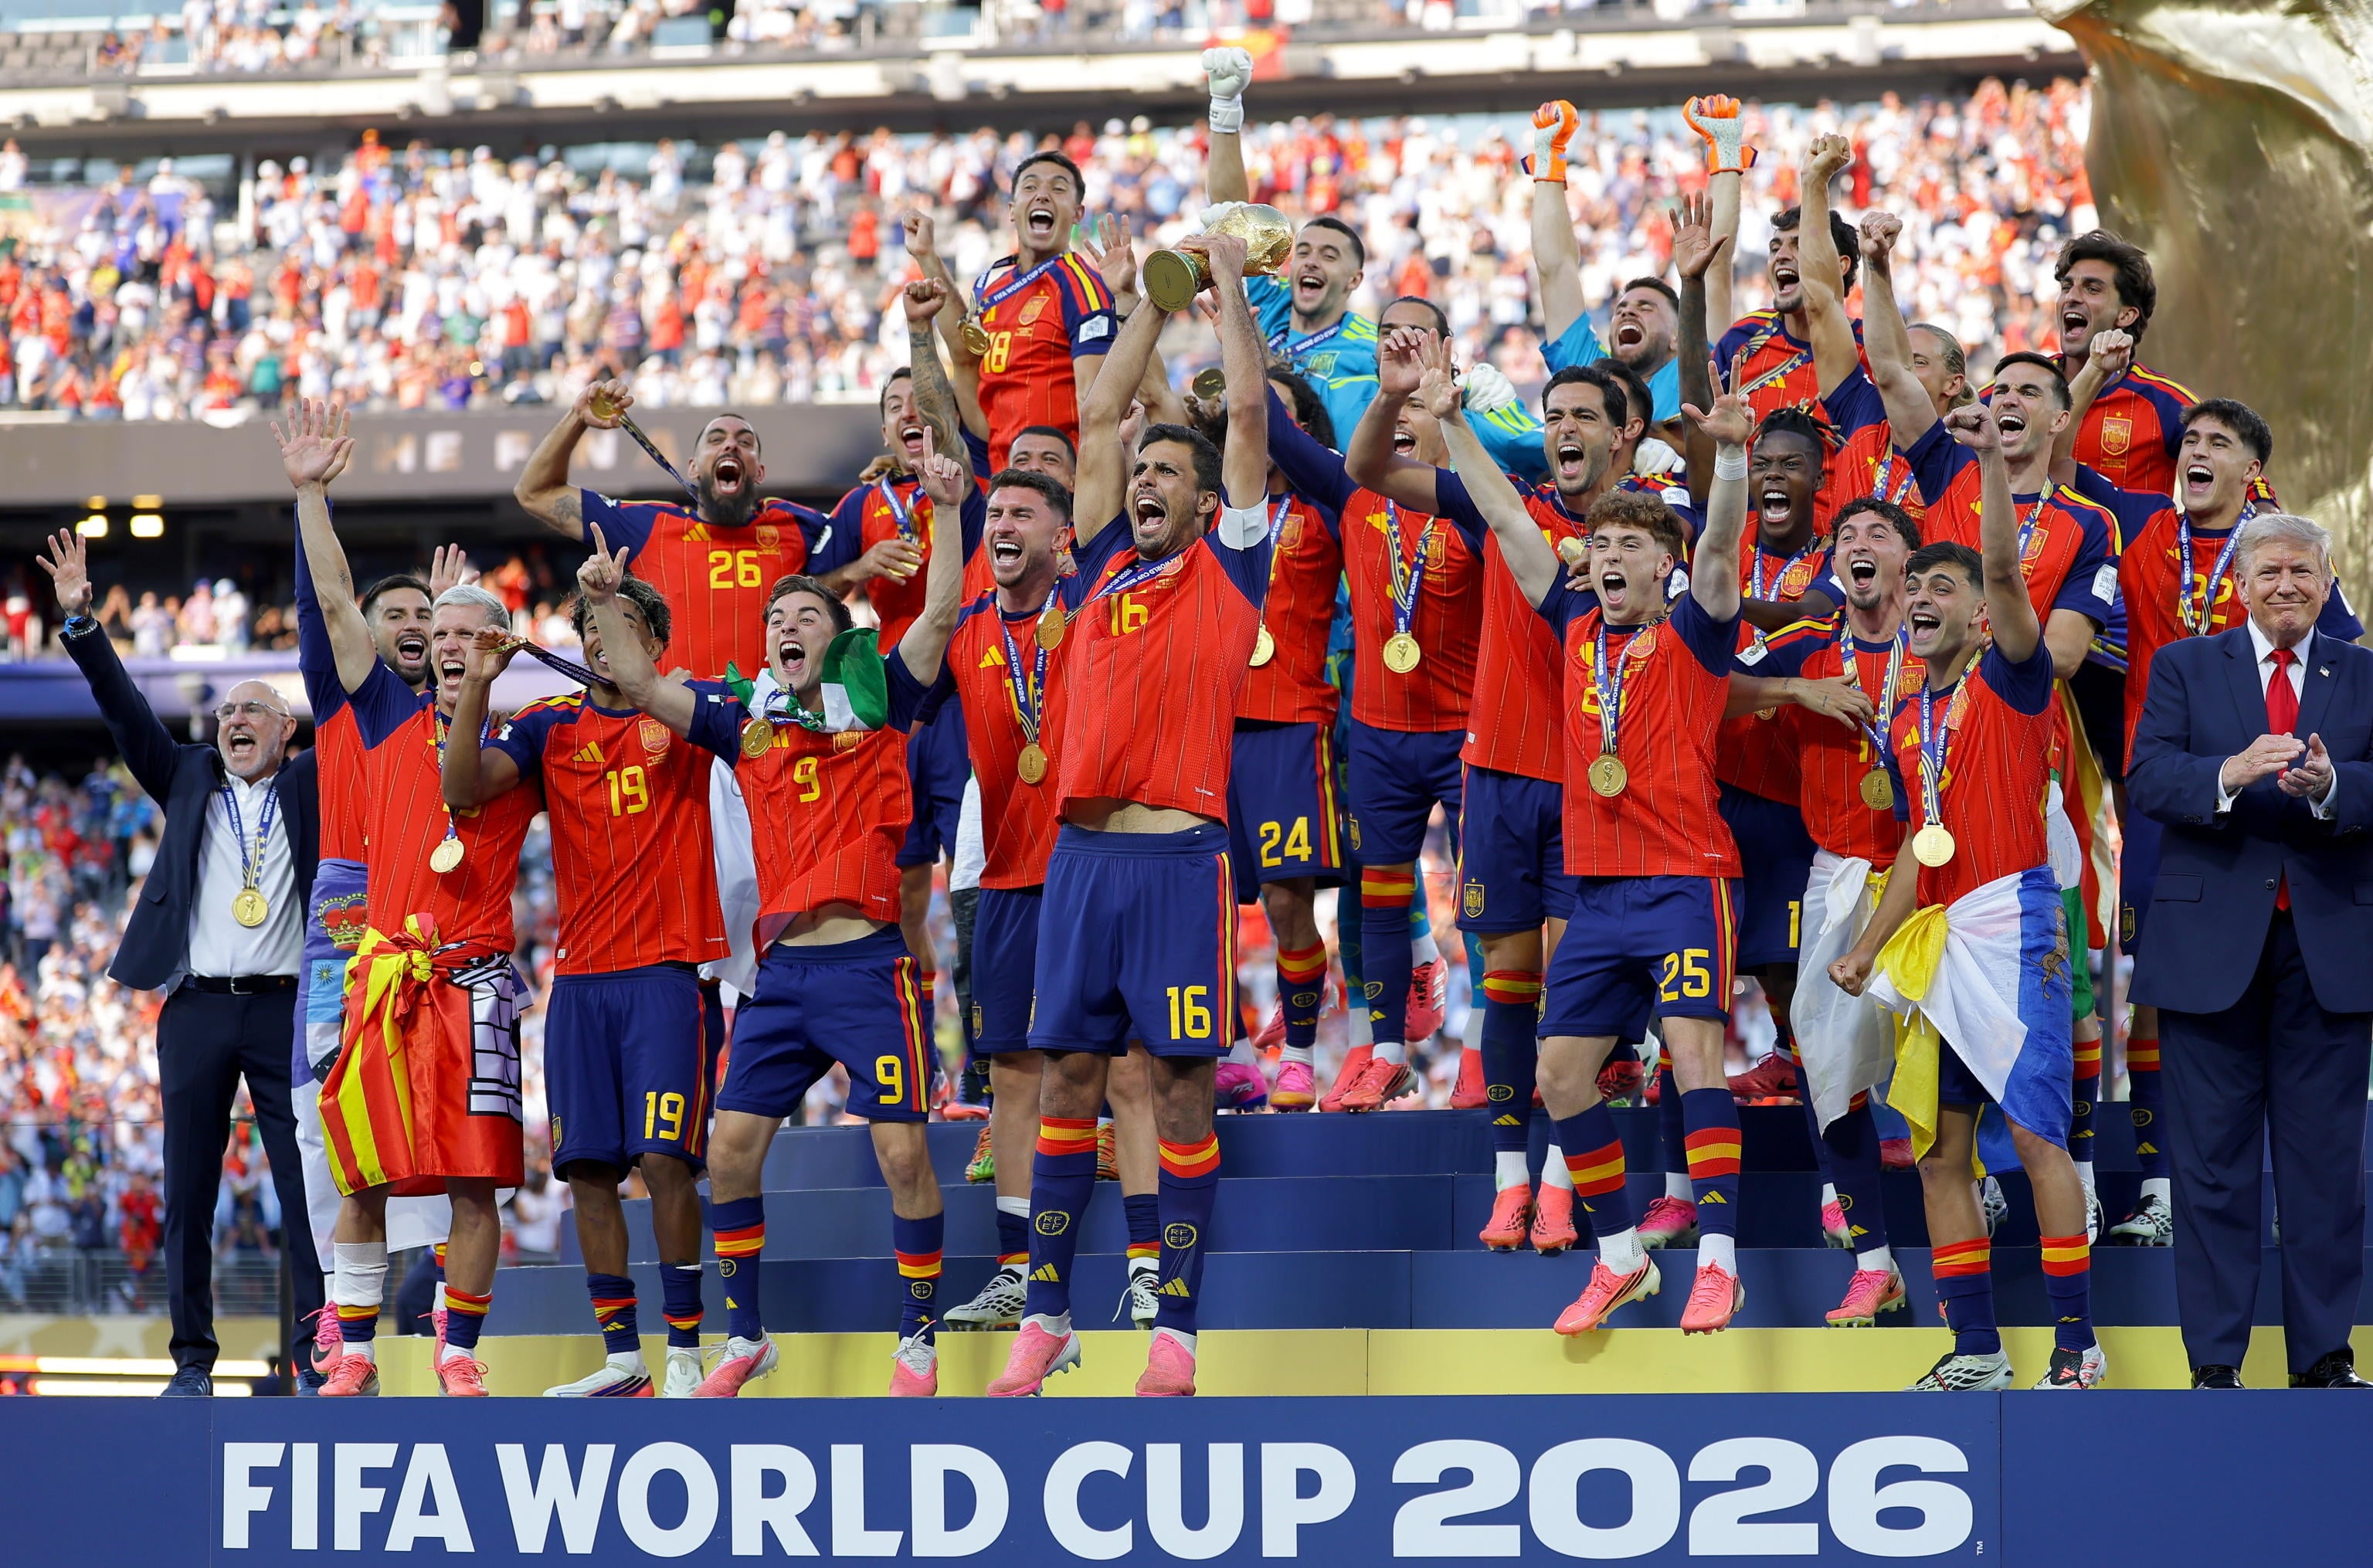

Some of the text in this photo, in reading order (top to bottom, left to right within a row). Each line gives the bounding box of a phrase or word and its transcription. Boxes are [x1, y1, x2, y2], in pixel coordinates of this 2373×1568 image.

[993, 291, 1007, 302] FIFA
[1007, 277, 1027, 297] WORLD
[1027, 271, 1038, 283] CUP
[983, 331, 1011, 373] 18
[1278, 498, 1291, 519] 2026
[708, 549, 761, 589] 26
[1137, 572, 1150, 581] CUP
[1149, 559, 1173, 575] WORLD
[2210, 519, 2247, 589] FIFA WORLD CUP 2026
[1409, 570, 1419, 596] 2026
[1769, 557, 1800, 602] ORLD CUP 2026
[2177, 573, 2234, 624] 22
[1110, 589, 1149, 636] 16
[1007, 633, 1017, 662] WORLD
[1015, 676, 1026, 703] 2026
[1937, 728, 1947, 755] WORLD
[606, 765, 649, 816] 19
[793, 757, 820, 803] 9
[229, 803, 239, 824] WORLD
[263, 791, 277, 823] CUP 2026
[1259, 816, 1312, 868] 24
[1659, 949, 1710, 1003] 25
[1167, 986, 1210, 1040] 16
[875, 1055, 902, 1104] 9
[645, 1091, 684, 1141] 19
[223, 1436, 1972, 1560] FIFA WORLD CUP 2026
